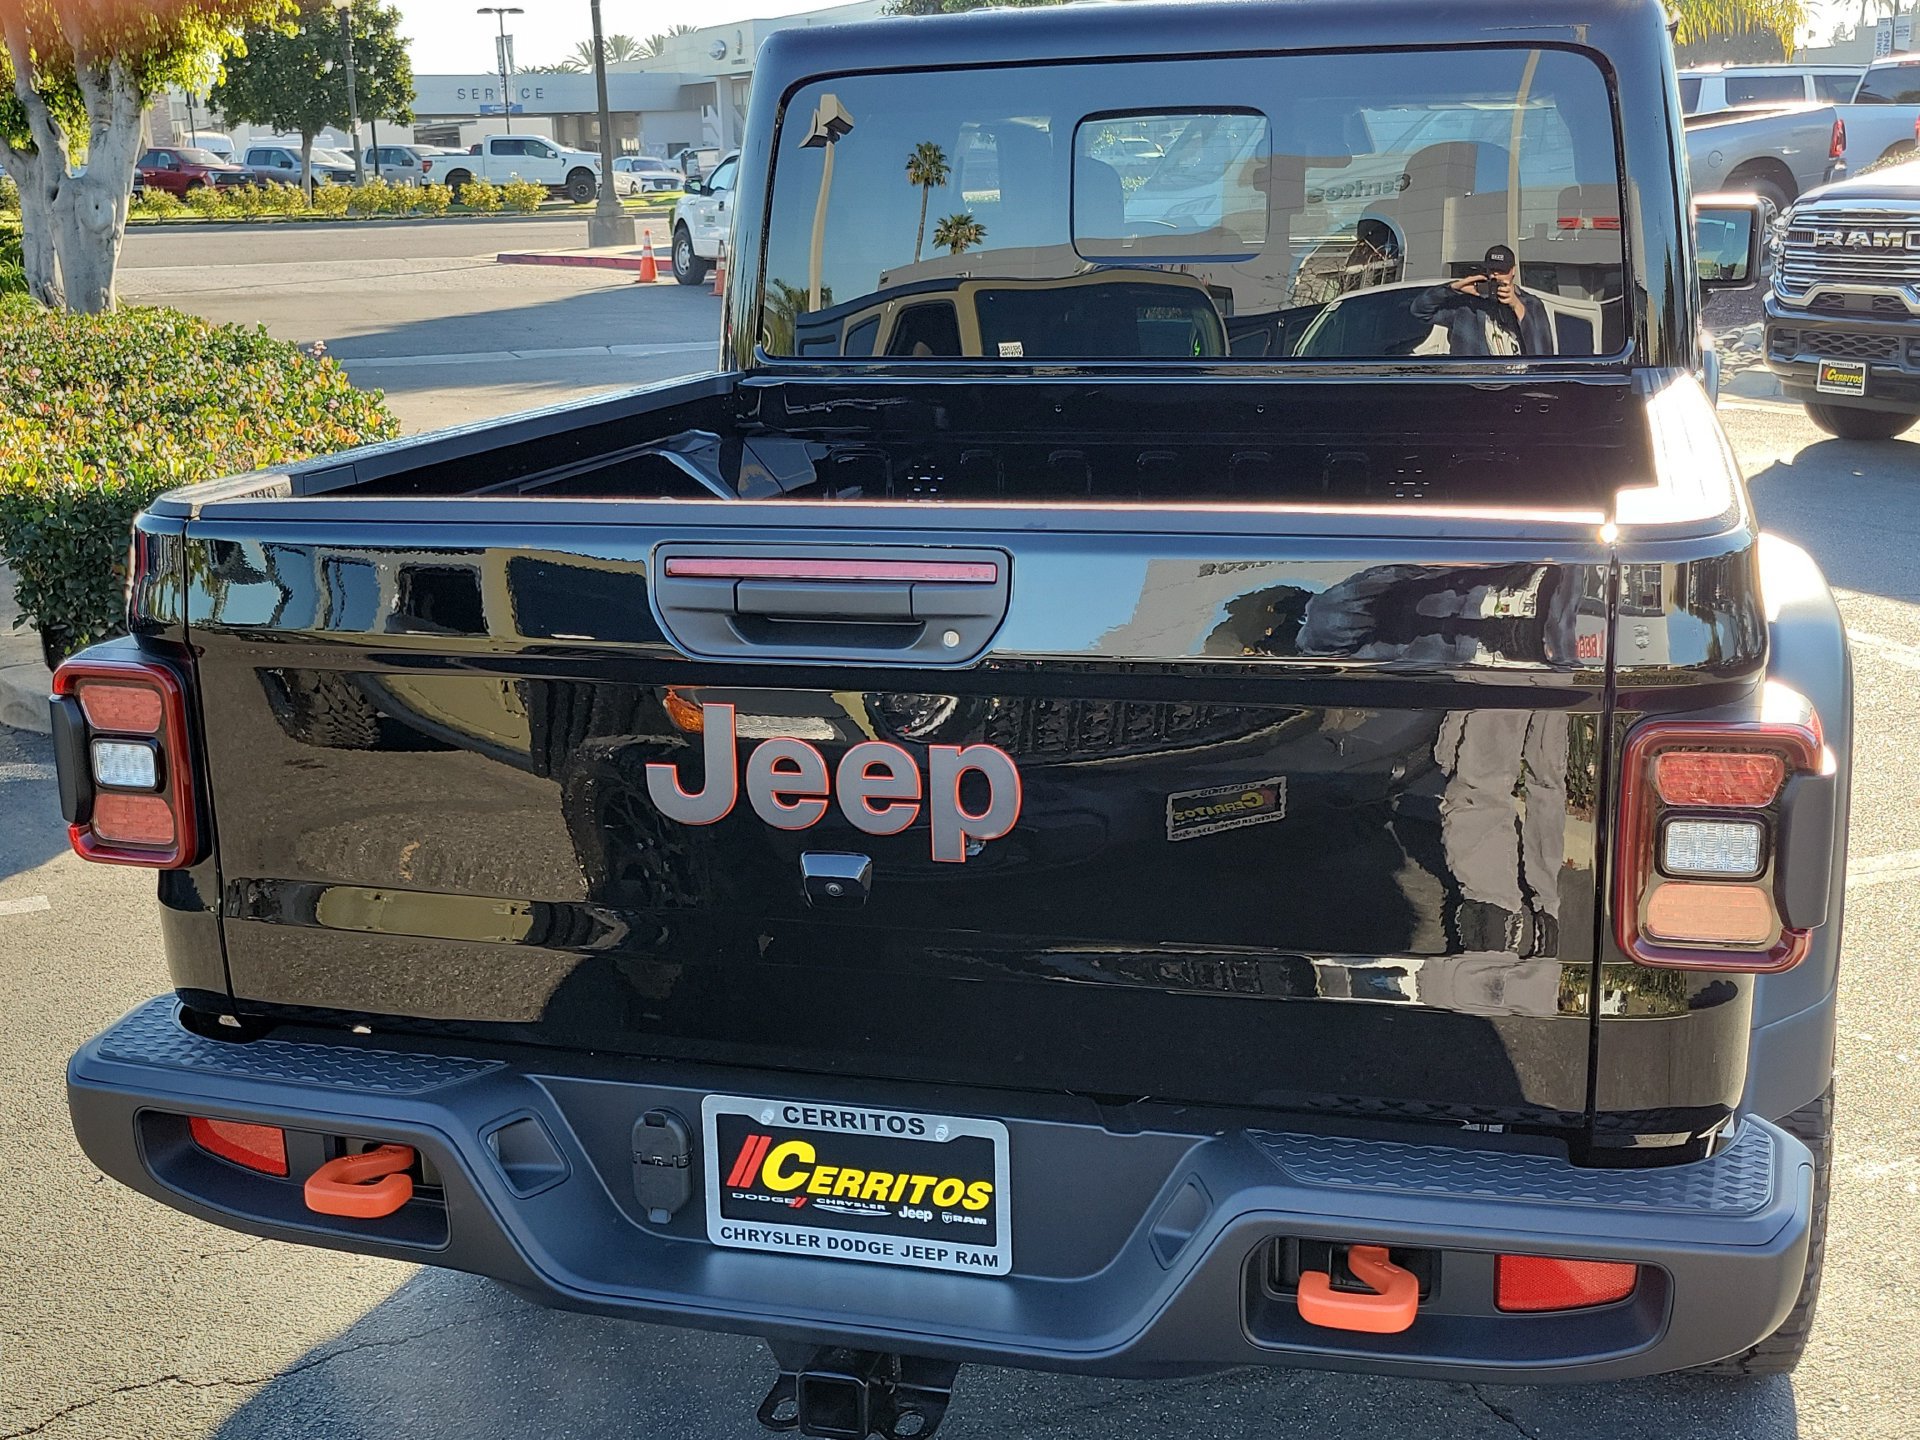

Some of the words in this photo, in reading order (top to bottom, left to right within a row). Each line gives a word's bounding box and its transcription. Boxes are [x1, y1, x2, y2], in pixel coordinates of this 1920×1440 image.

[457, 87, 544, 99] SERCE
[1817, 230, 1903, 247] RAM
[645, 702, 1022, 862] Jeep
[783, 1106, 926, 1135] CERRITOS
[761, 1140, 994, 1211] CERRITOS
[732, 1192, 796, 1205] DODGE
[816, 1198, 886, 1211] CHRYSLER
[898, 1206, 933, 1223] Jeep
[952, 1214, 988, 1225] RAM
[720, 1226, 821, 1249] CHRYSLER
[827, 1236, 894, 1256] DODGE
[900, 1245, 949, 1262] JEEP
[955, 1251, 999, 1268] RAM
